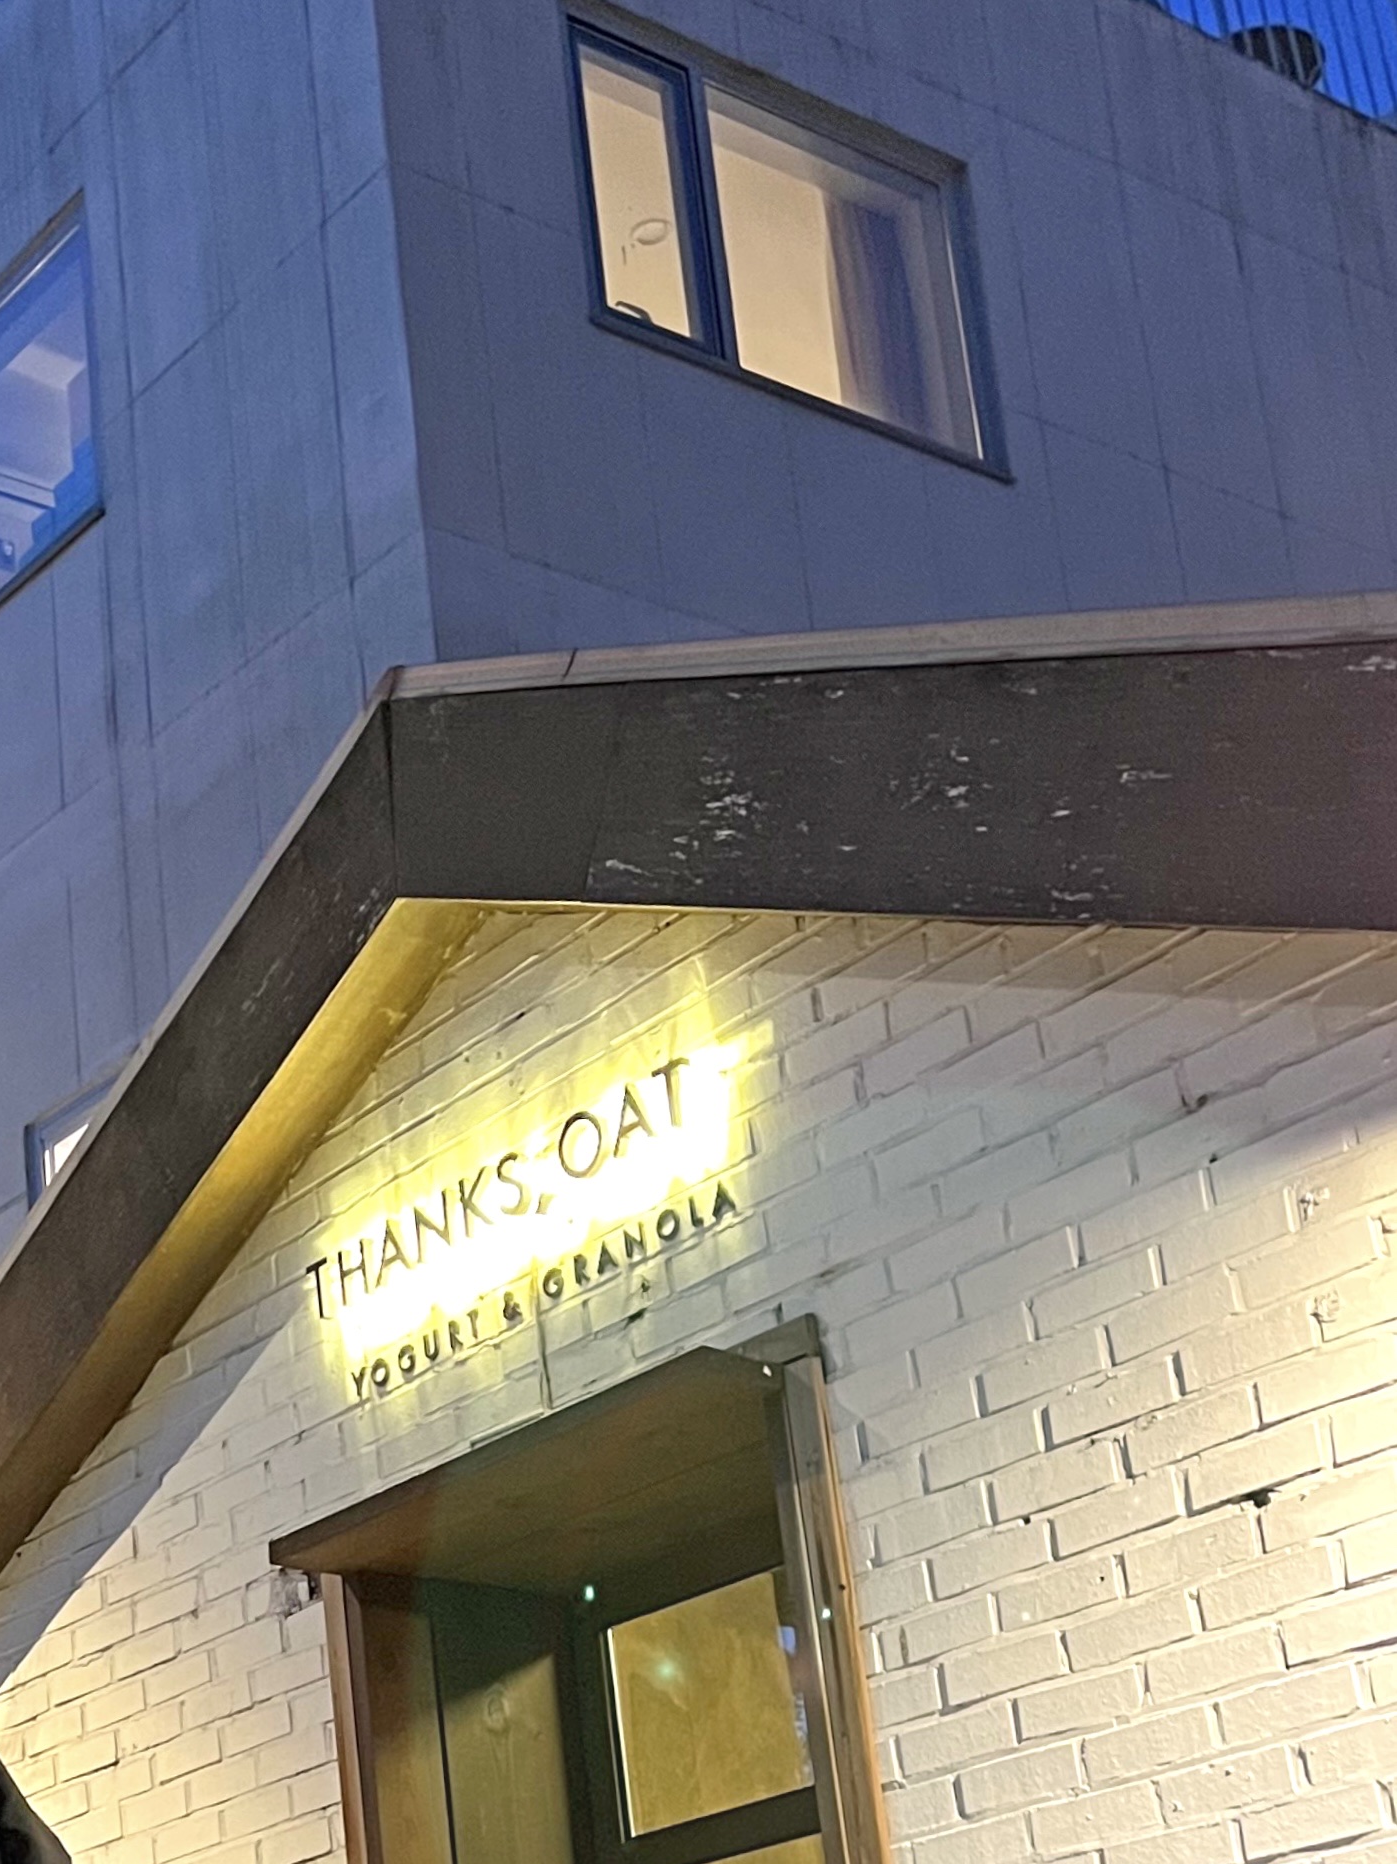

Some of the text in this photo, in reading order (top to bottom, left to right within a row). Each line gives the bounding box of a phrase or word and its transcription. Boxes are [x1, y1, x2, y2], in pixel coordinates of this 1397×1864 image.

[306, 1057, 689, 1319] THANKS, OAT
[351, 1180, 737, 1401] YOGURT & GRANOLA
